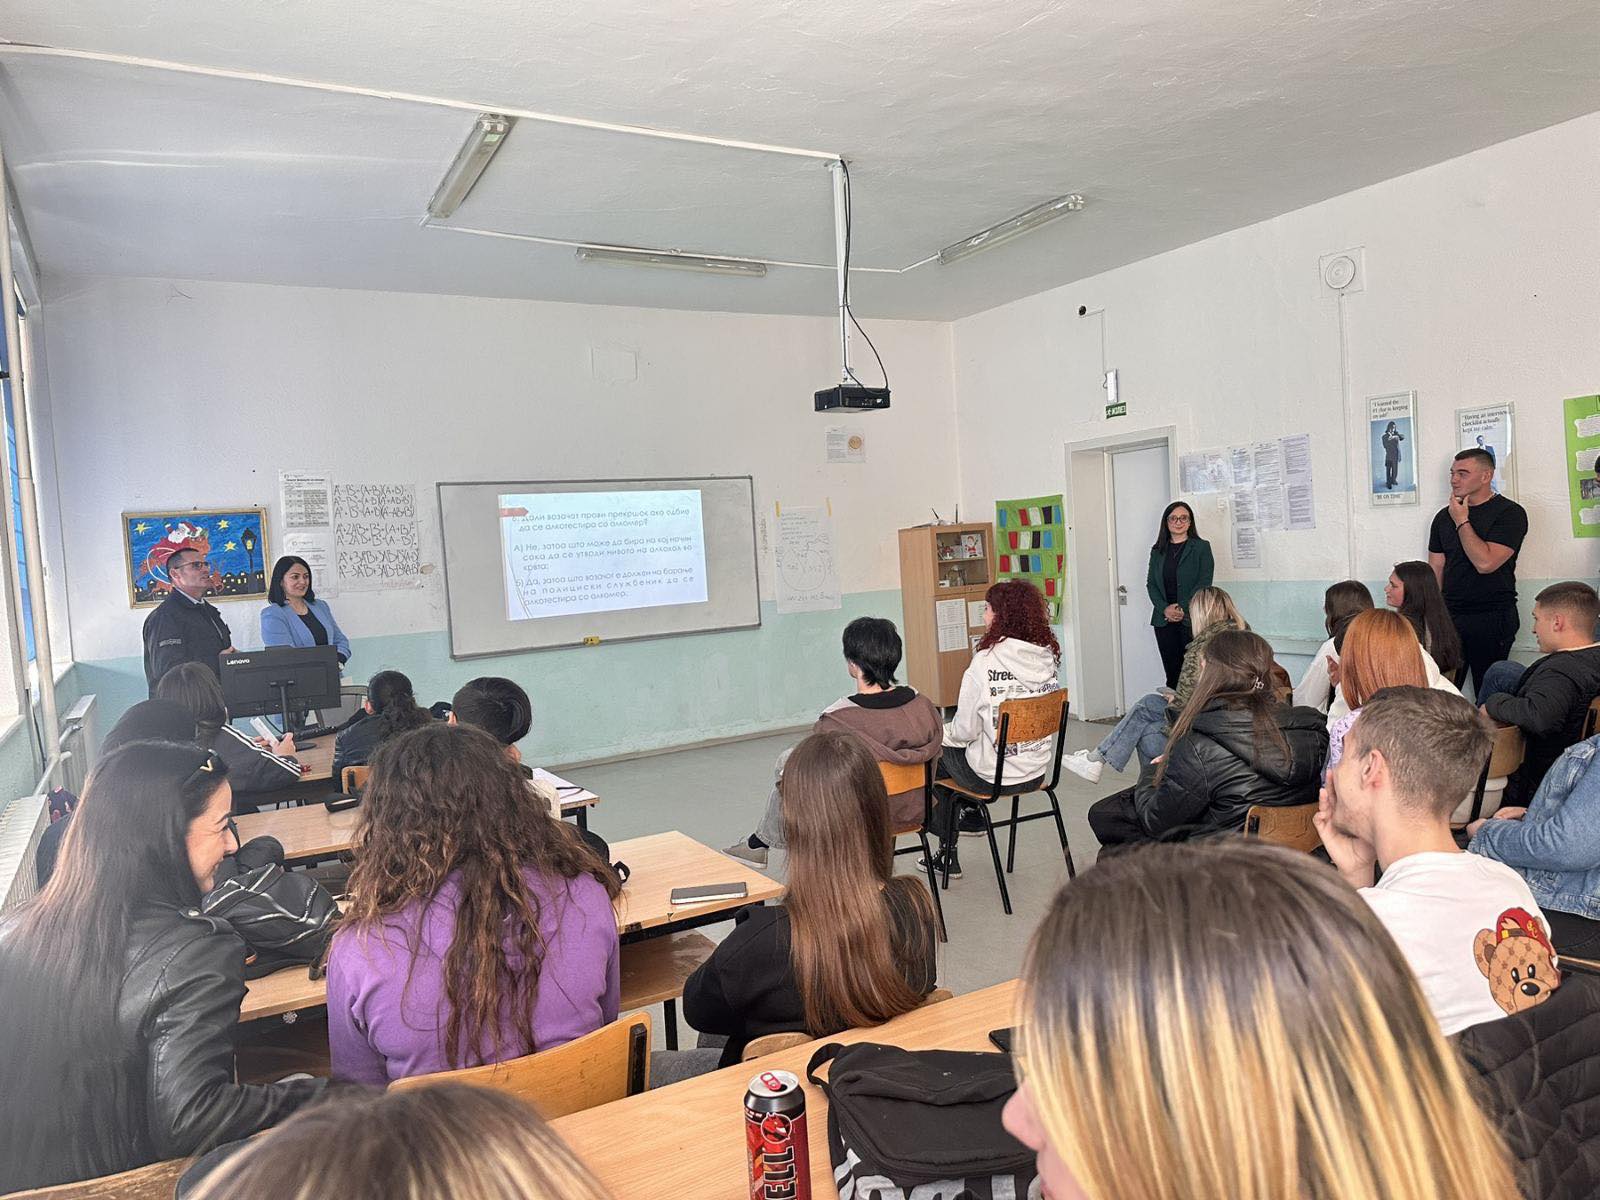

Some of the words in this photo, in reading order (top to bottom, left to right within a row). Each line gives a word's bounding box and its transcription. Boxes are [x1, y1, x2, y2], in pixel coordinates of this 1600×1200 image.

[547, 512, 579, 520] возачот
[582, 512, 606, 520] прави
[519, 524, 530, 532] да
[545, 522, 596, 530] алкотестира
[543, 542, 567, 550] затоа
[586, 540, 610, 548] може
[624, 538, 644, 546] бира
[658, 536, 668, 544] кој
[522, 554, 546, 562] сака
[576, 550, 605, 559] утврди
[606, 548, 634, 556] нивото
[542, 576, 566, 584] затоа
[622, 570, 651, 578] должен
[663, 567, 694, 575] барање
[542, 583, 602, 594] полициски
[606, 578, 664, 589] службеник
[524, 595, 577, 606] алкотестира
[988, 669, 1018, 682] Stree
[762, 1145, 797, 1200] ELL
